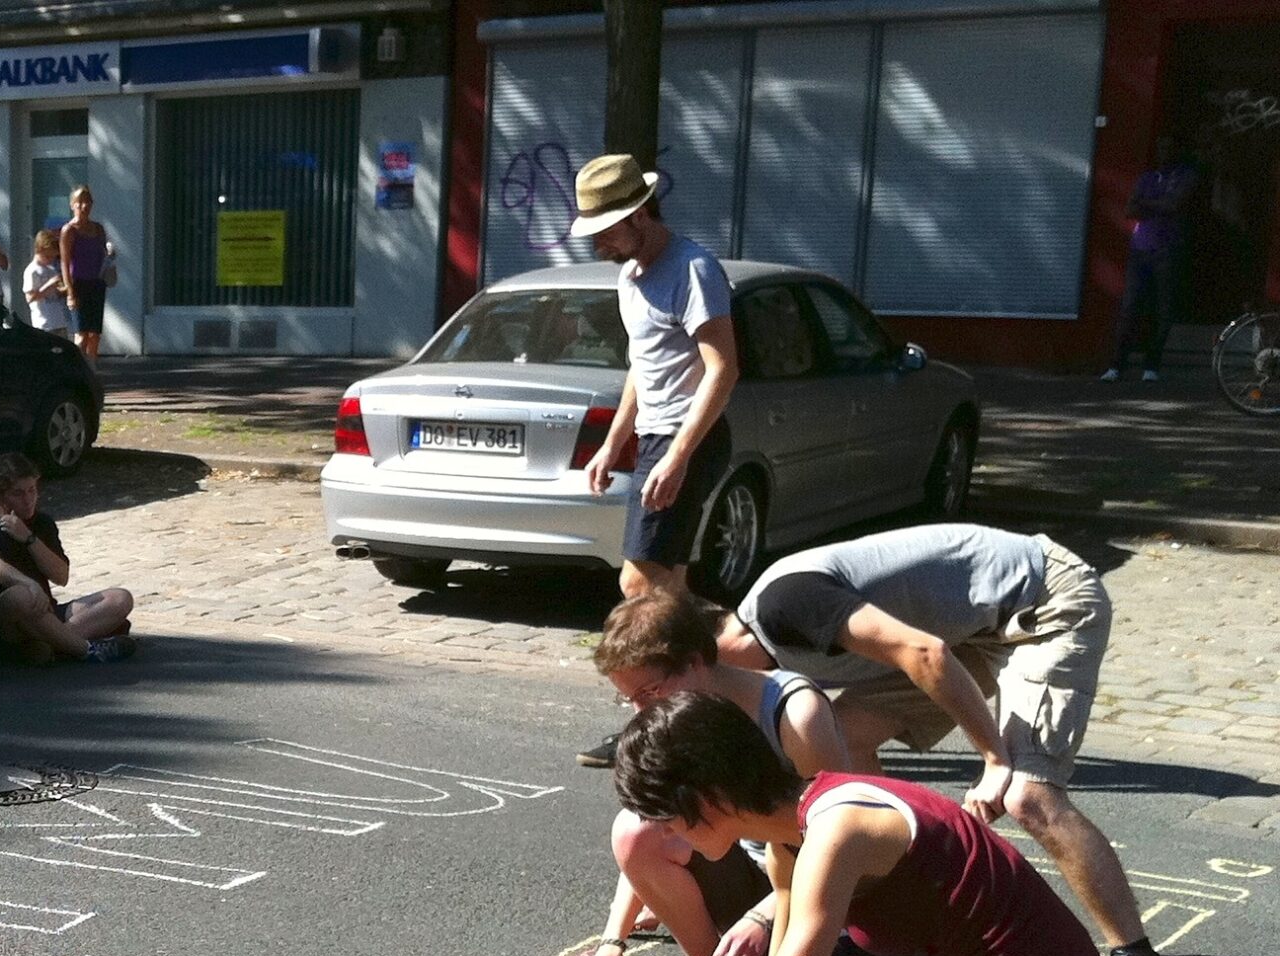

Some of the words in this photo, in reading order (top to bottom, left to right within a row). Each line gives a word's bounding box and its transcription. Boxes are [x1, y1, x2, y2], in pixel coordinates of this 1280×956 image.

[422, 424, 445, 445] DO
[456, 426, 479, 447] EV
[484, 428, 519, 449] 381
